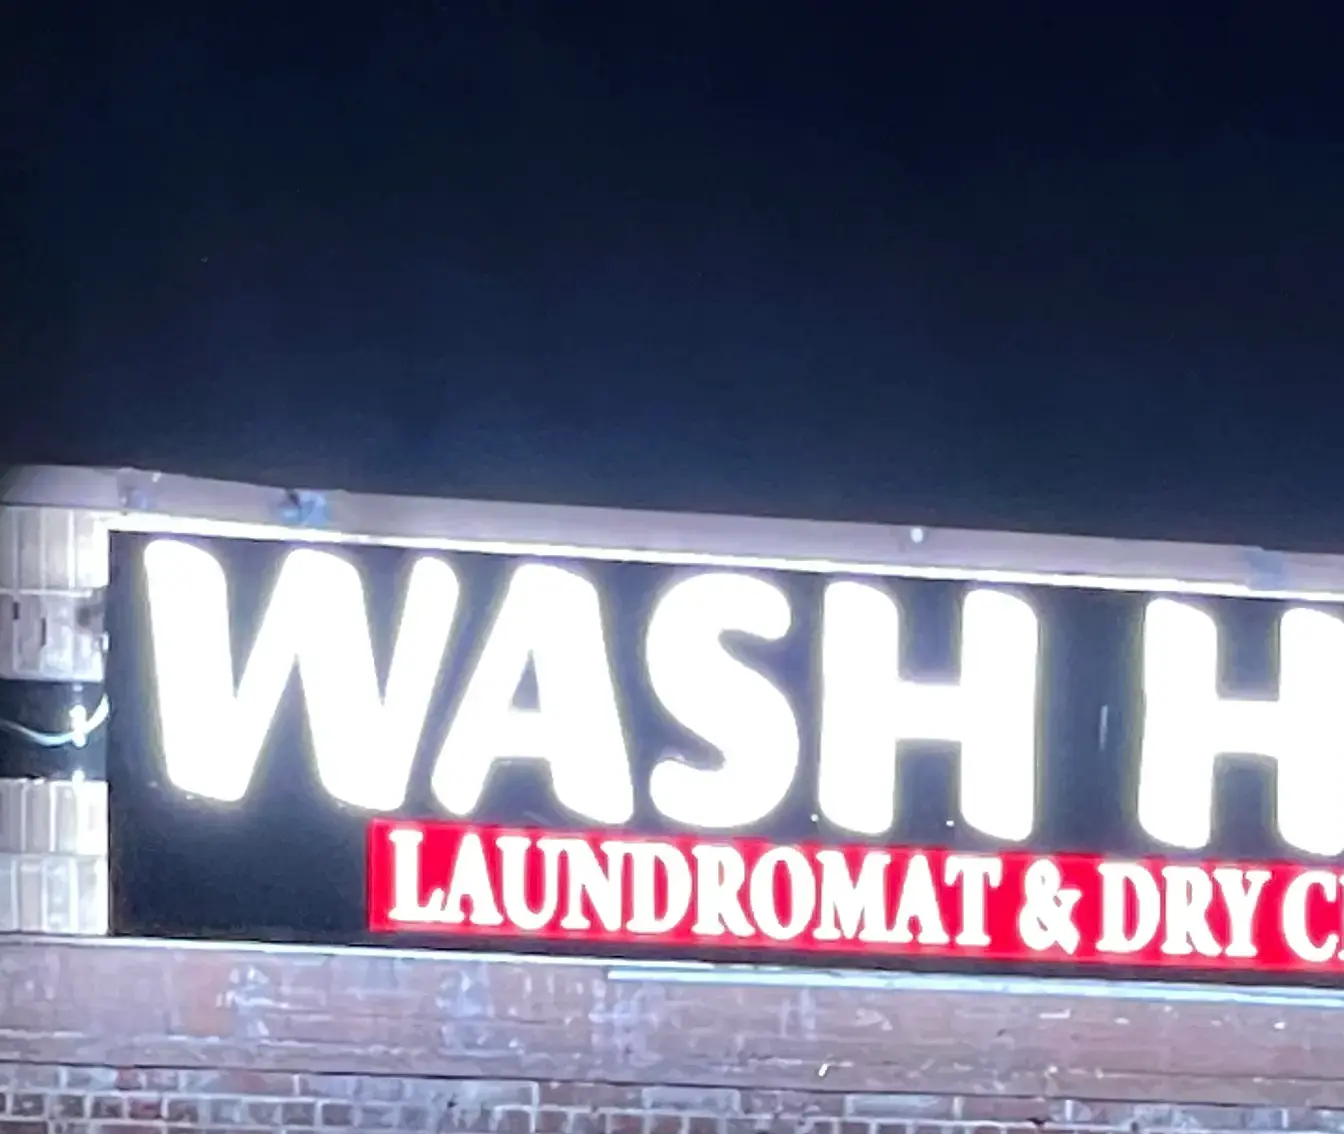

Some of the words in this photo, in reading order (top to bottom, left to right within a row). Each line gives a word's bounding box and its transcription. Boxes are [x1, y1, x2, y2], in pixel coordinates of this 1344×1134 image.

[143, 538, 1040, 842] WASH
[387, 826, 1003, 949] LAUNDROMAT
[1018, 858, 1082, 957] &
[1096, 860, 1273, 964] DRY
